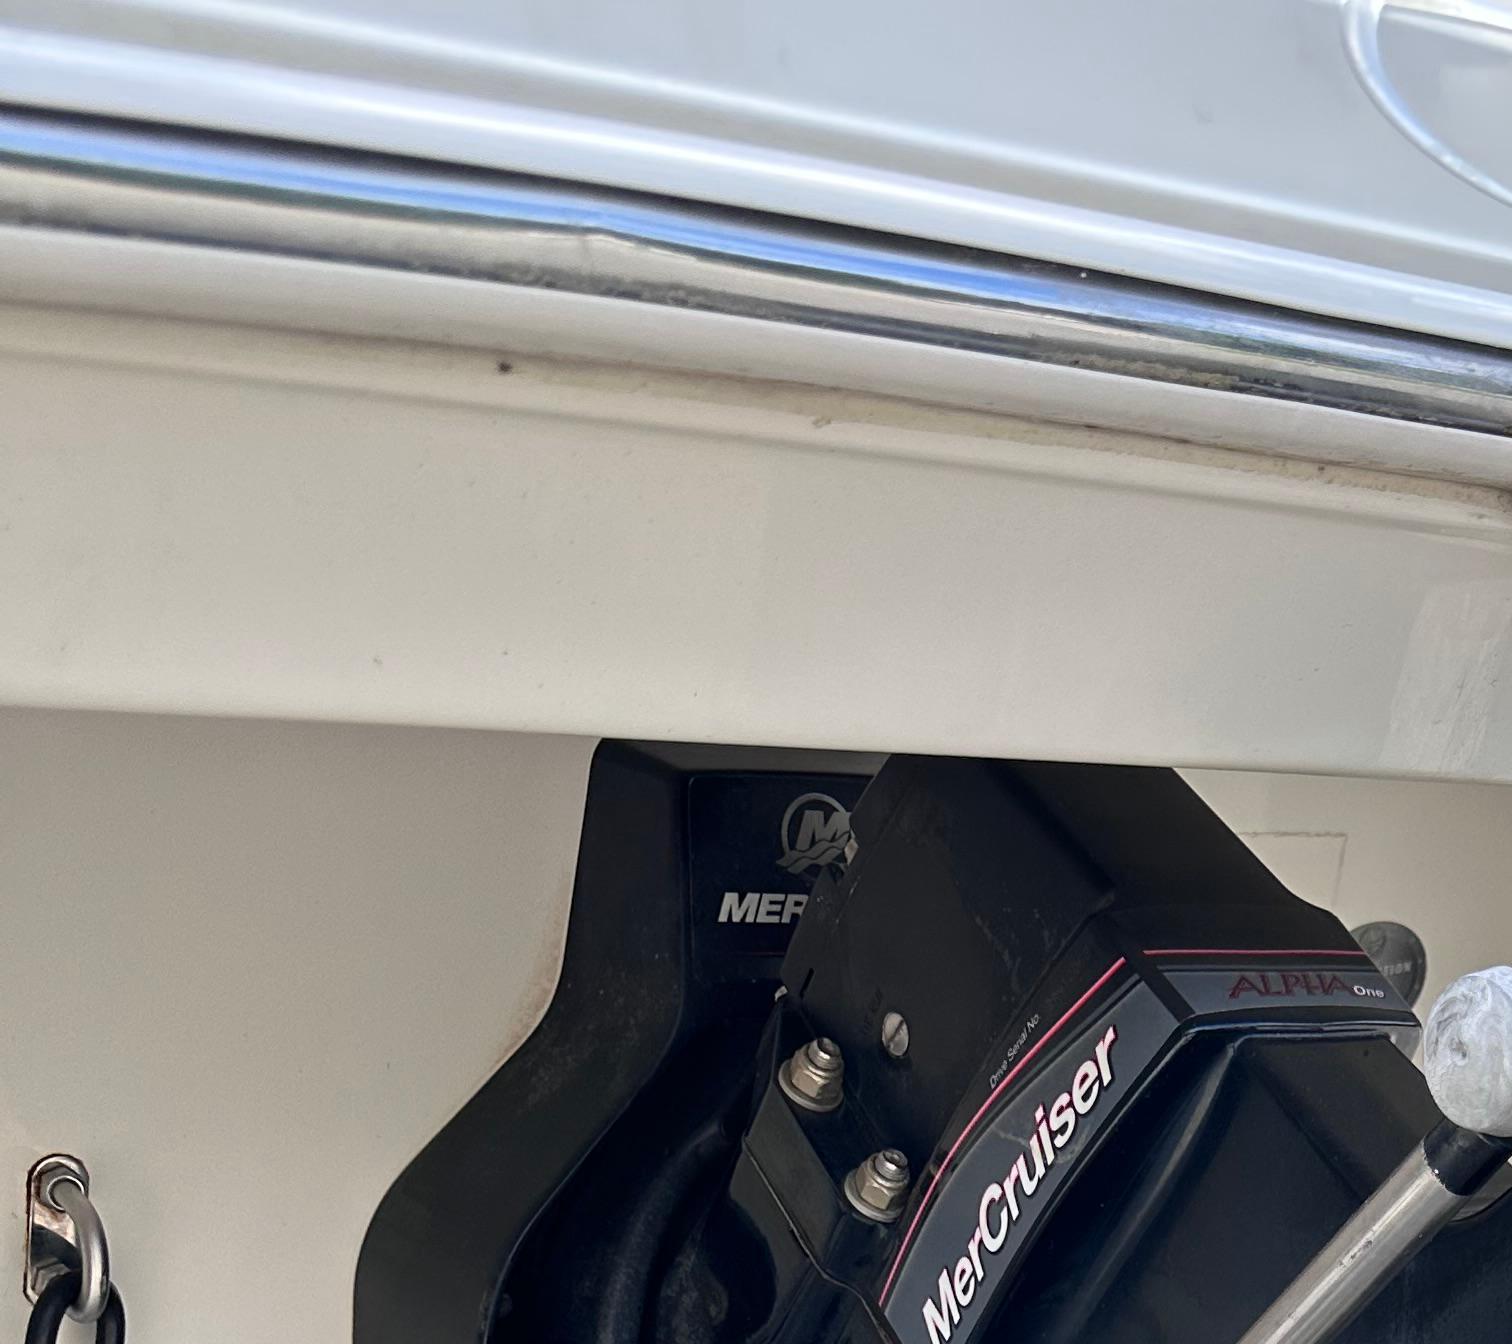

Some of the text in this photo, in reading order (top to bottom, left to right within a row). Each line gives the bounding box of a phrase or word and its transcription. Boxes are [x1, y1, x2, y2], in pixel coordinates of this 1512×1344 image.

[1228, 973, 1386, 1000] ALPHA One
[989, 1059, 1008, 1090] Drive
[1007, 1027, 1028, 1062] Serial
